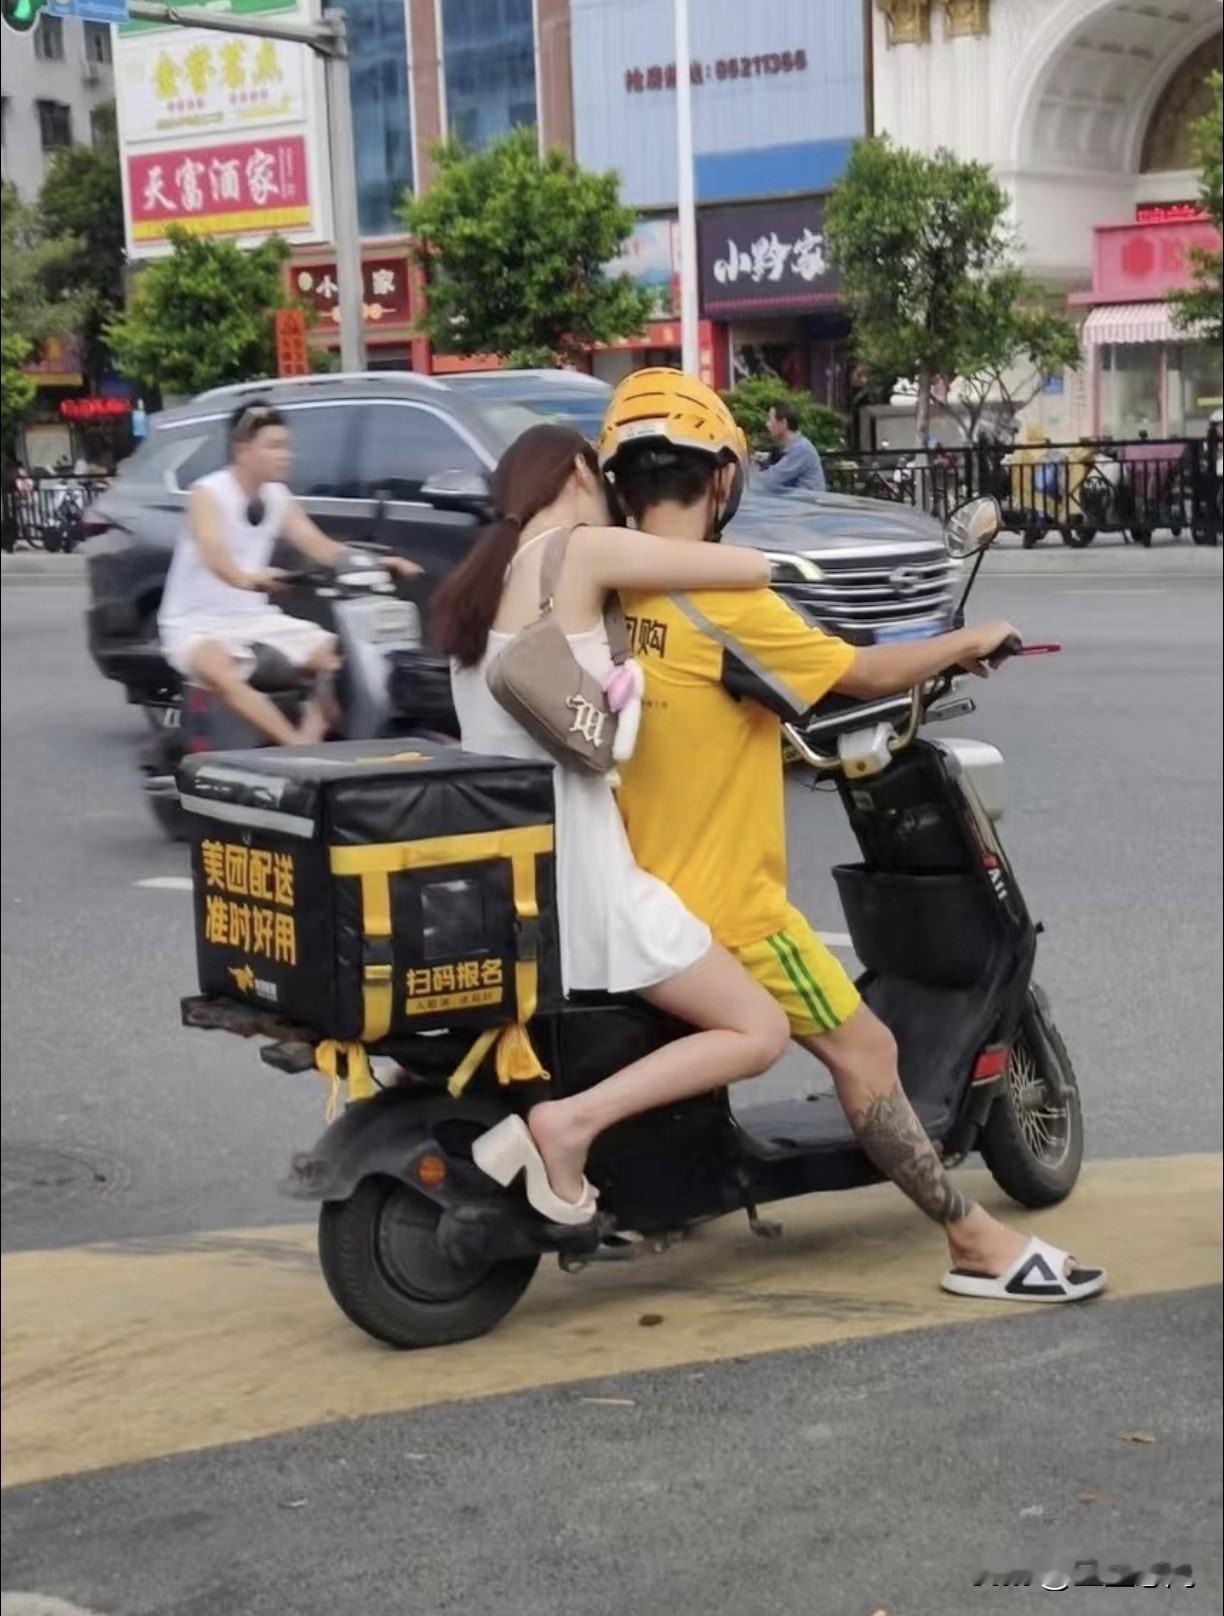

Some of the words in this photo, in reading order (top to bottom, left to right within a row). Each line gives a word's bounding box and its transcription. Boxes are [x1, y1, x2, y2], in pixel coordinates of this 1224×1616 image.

[143, 146, 279, 211] 天富酒家
[315, 268, 396, 298] 小家
[201, 838, 295, 908] 美团配送
[205, 894, 297, 966] 准时好用
[405, 957, 504, 996] 扫码报名
